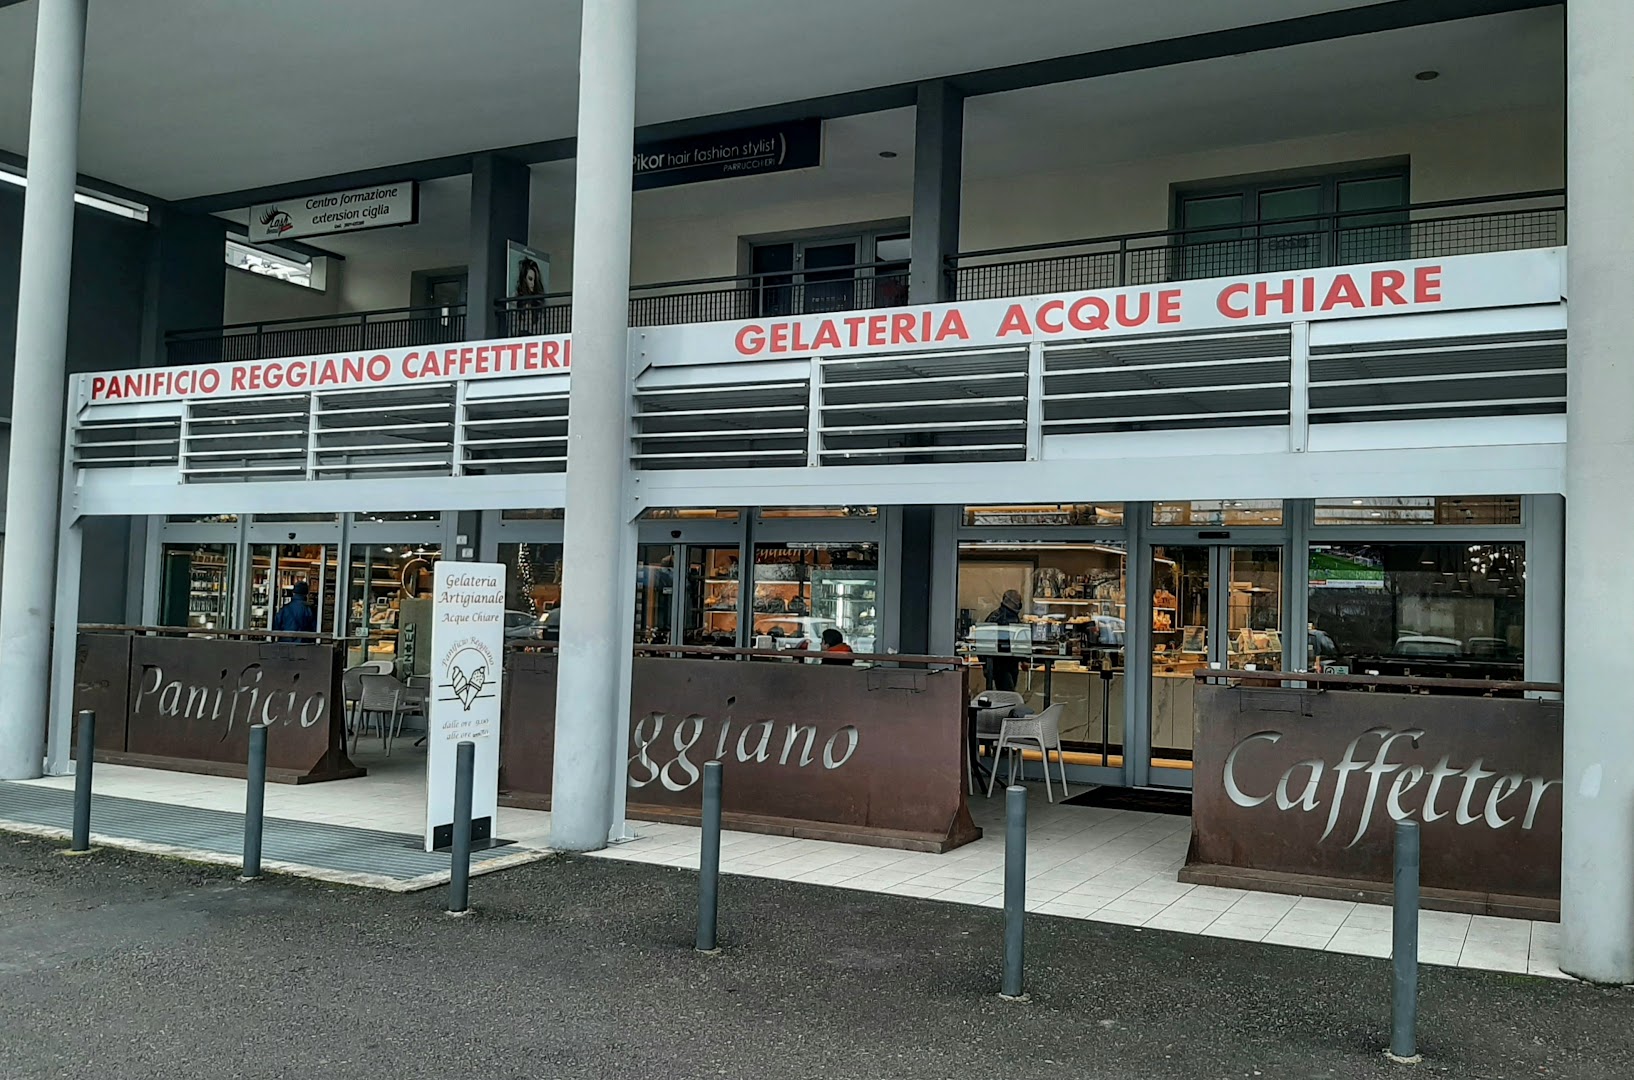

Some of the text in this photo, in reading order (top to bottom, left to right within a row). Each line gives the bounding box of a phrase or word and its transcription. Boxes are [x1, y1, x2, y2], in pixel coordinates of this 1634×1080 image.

[667, 151, 690, 166] hair
[694, 144, 739, 162] fashion
[742, 138, 775, 158] stylist
[305, 187, 398, 210] Centro formazione
[312, 210, 360, 225] extension
[362, 204, 389, 220] ciglia
[735, 265, 1443, 356] GELATERIA ACQUE CHIARE
[91, 339, 572, 400] PANIFICIO REGGIANO CAFFETTERI
[446, 573, 497, 589] Gelateria
[437, 590, 504, 608] Artigianale
[442, 611, 500, 625] Acque Chiare
[133, 663, 325, 742] Panificio
[1222, 725, 1564, 849] Caffetter
